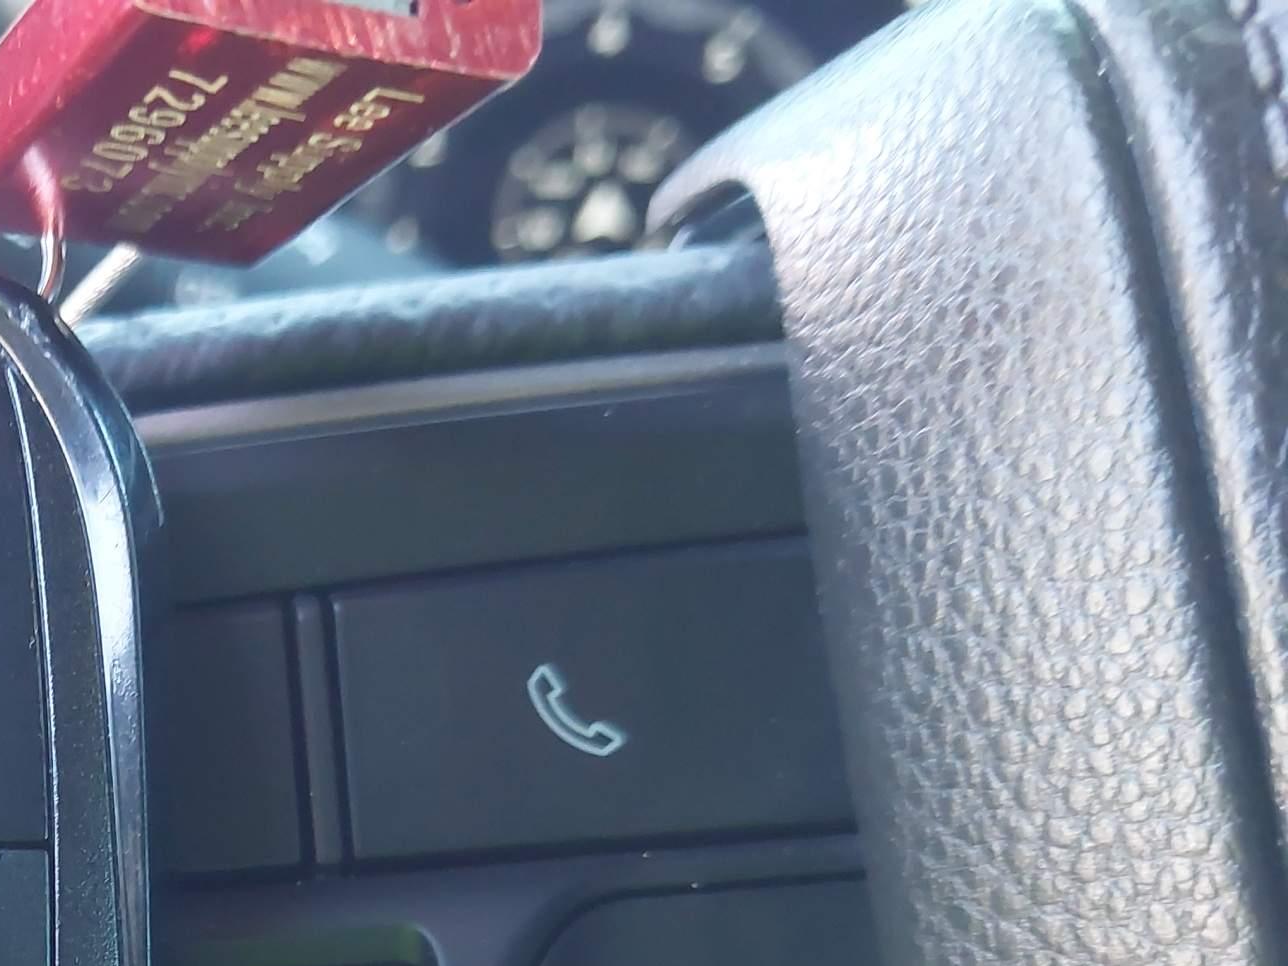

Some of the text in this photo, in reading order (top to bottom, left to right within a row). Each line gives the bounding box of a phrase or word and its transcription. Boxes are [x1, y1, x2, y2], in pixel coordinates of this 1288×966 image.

[60, 69, 228, 193] 7296073
[333, 87, 425, 131] Lee
[233, 132, 364, 198] Supply
